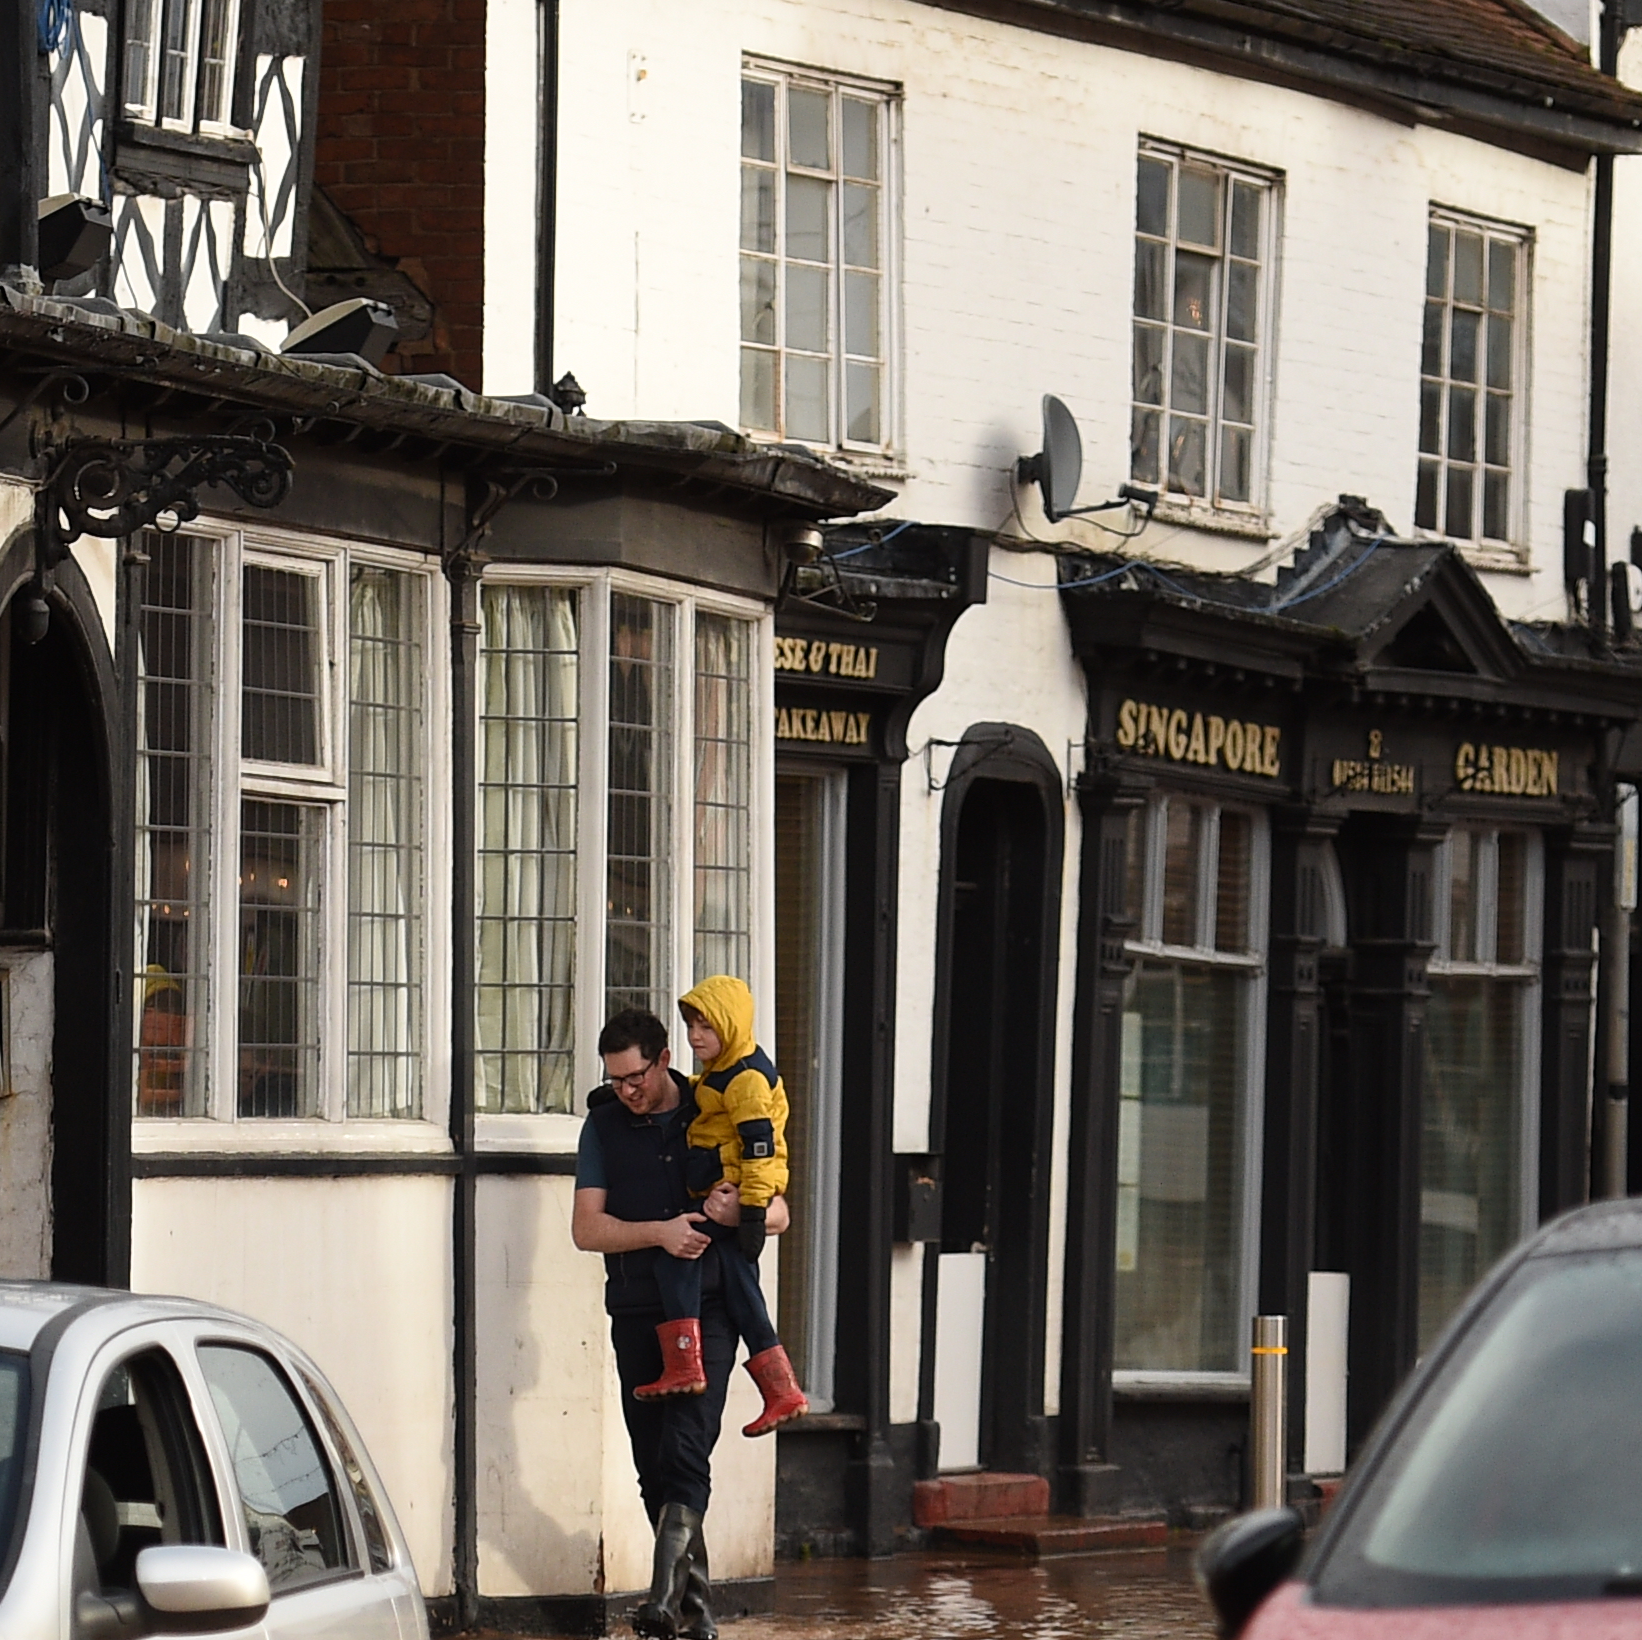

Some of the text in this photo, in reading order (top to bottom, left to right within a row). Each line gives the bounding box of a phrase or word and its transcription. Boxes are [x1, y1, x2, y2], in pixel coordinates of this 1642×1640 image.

[828, 642, 878, 679] THAI
[774, 707, 870, 744] AKEAWAY
[1116, 698, 1281, 778] SINGAPORE
[1456, 741, 1558, 796] GARDEN
